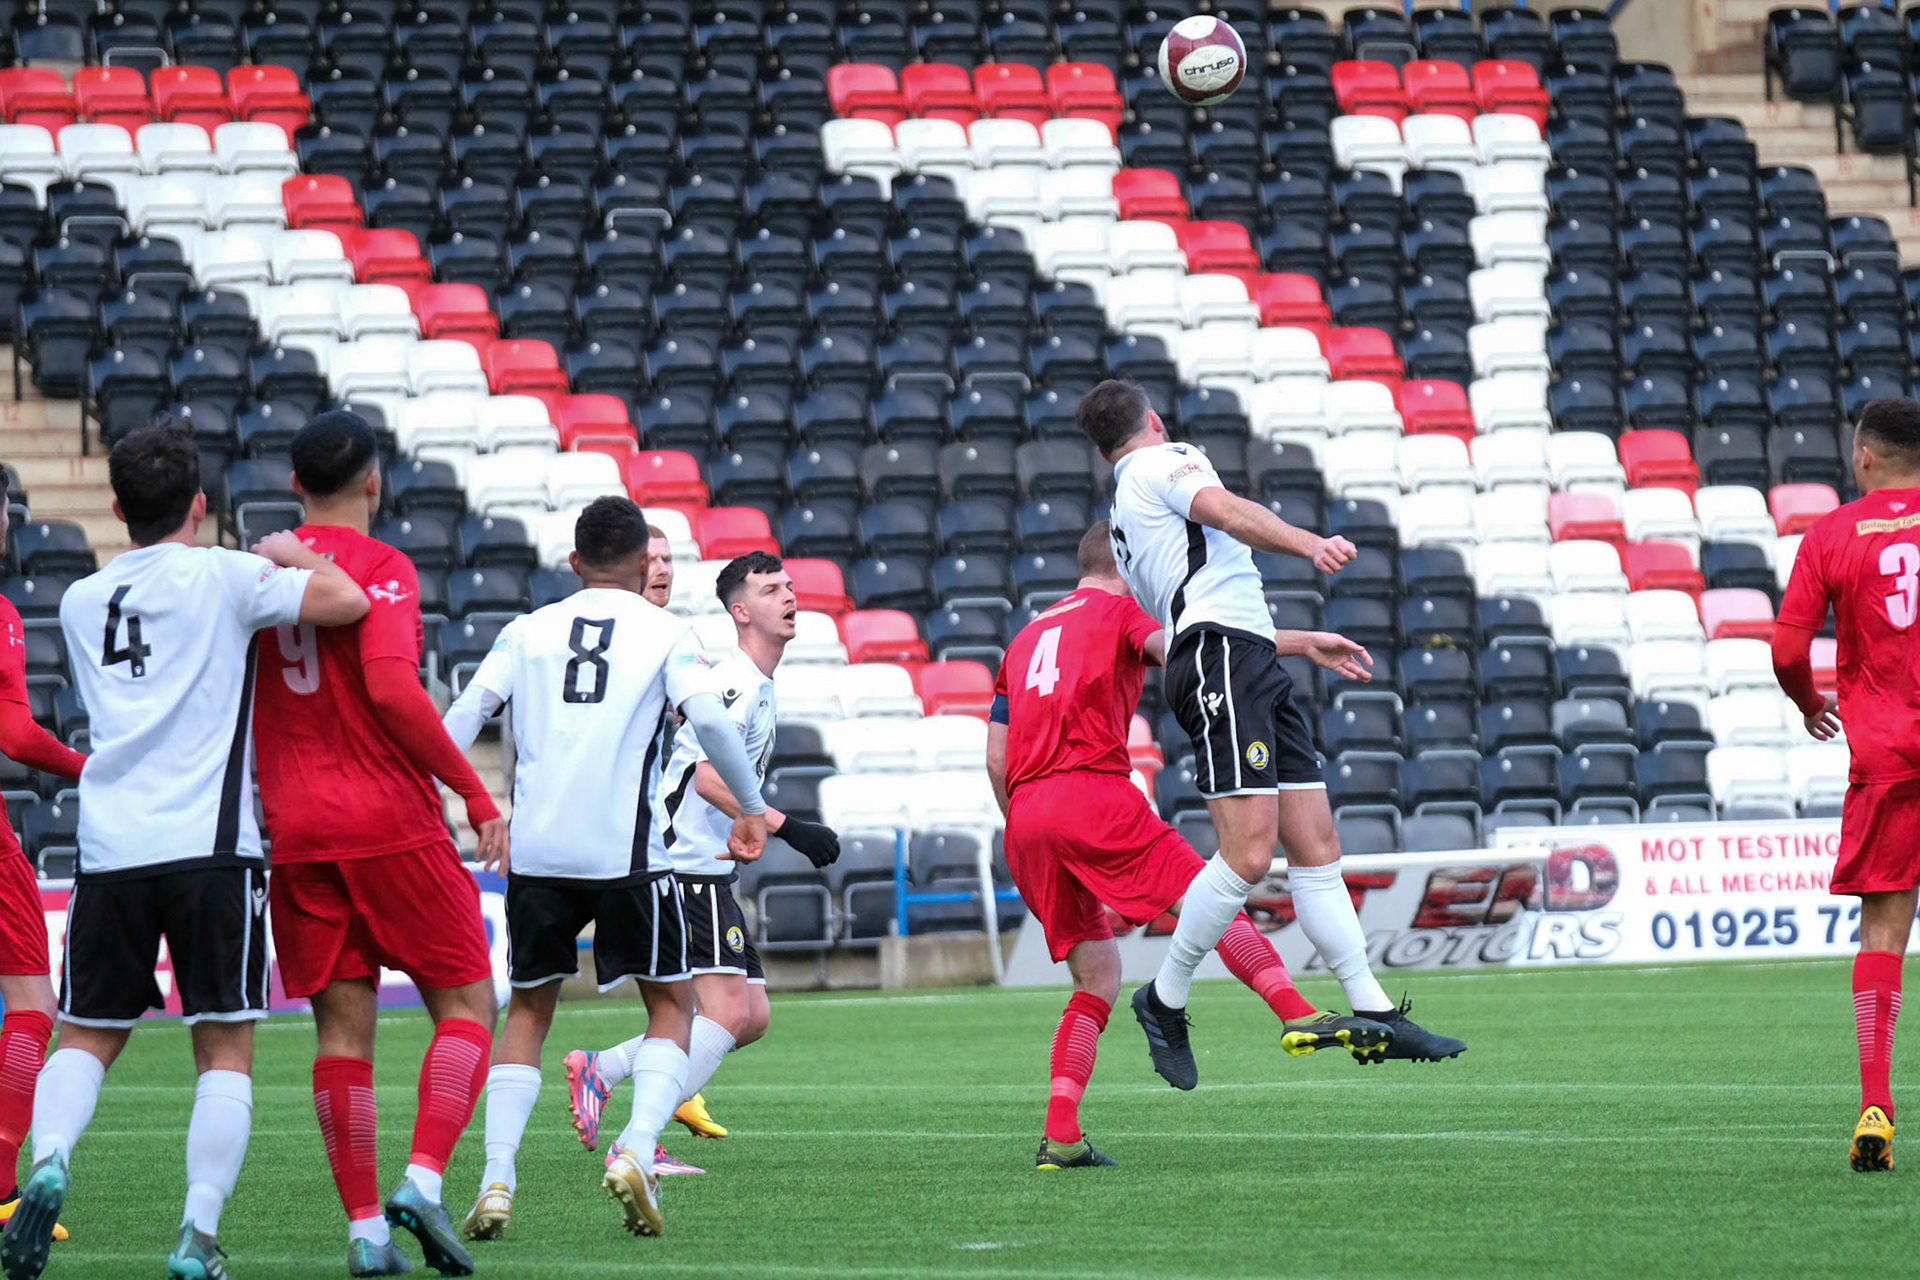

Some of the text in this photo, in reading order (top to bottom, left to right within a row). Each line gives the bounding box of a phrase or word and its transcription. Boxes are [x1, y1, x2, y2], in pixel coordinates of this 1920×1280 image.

[1184, 57, 1234, 76] chryso
[1879, 542, 1920, 627] 3
[101, 584, 151, 678] 4
[276, 622, 321, 695] 9
[563, 616, 616, 704] 8
[1026, 625, 1063, 697] 4
[1640, 837, 1705, 862] MOT
[1644, 876, 1658, 896] &
[1669, 874, 1710, 895] ALL
[1651, 904, 1799, 950] 01925
[484, 1197, 511, 1212] NIKE
